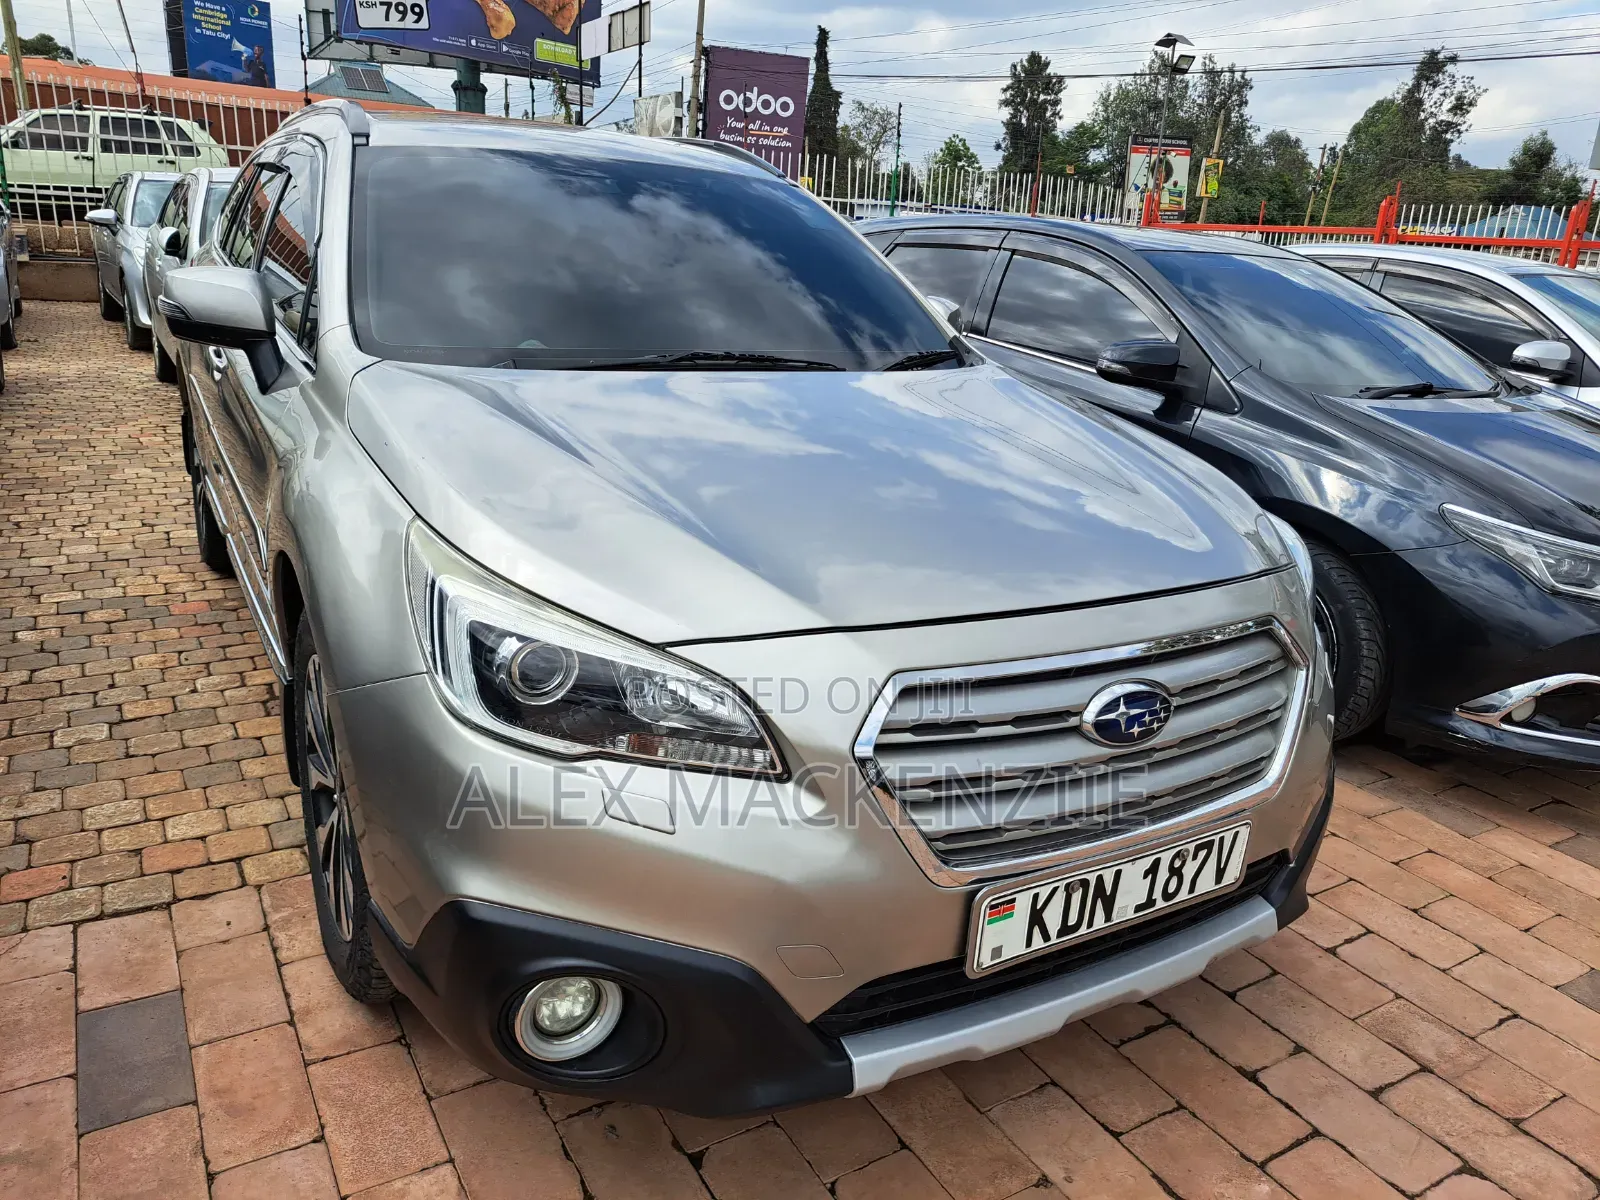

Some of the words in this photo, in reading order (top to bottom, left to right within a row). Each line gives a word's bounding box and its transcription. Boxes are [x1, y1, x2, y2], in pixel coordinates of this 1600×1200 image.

[205, 2, 220, 10] Have
[194, 7, 228, 19] Cambridge
[359, 1, 377, 9] KSH
[379, 1, 424, 24] 799
[192, 13, 231, 26] International
[201, 21, 222, 31] School
[203, 28, 216, 36] Tatu
[217, 31, 231, 40] City!
[542, 43, 573, 55] DOWNLOAD
[719, 87, 795, 118] odoo
[727, 116, 745, 128] Your
[748, 121, 761, 131] all
[762, 122, 771, 132] in
[773, 126, 788, 134] one
[759, 136, 792, 148] solution
[1025, 868, 1122, 949] KDN
[1133, 830, 1240, 914] 187V
